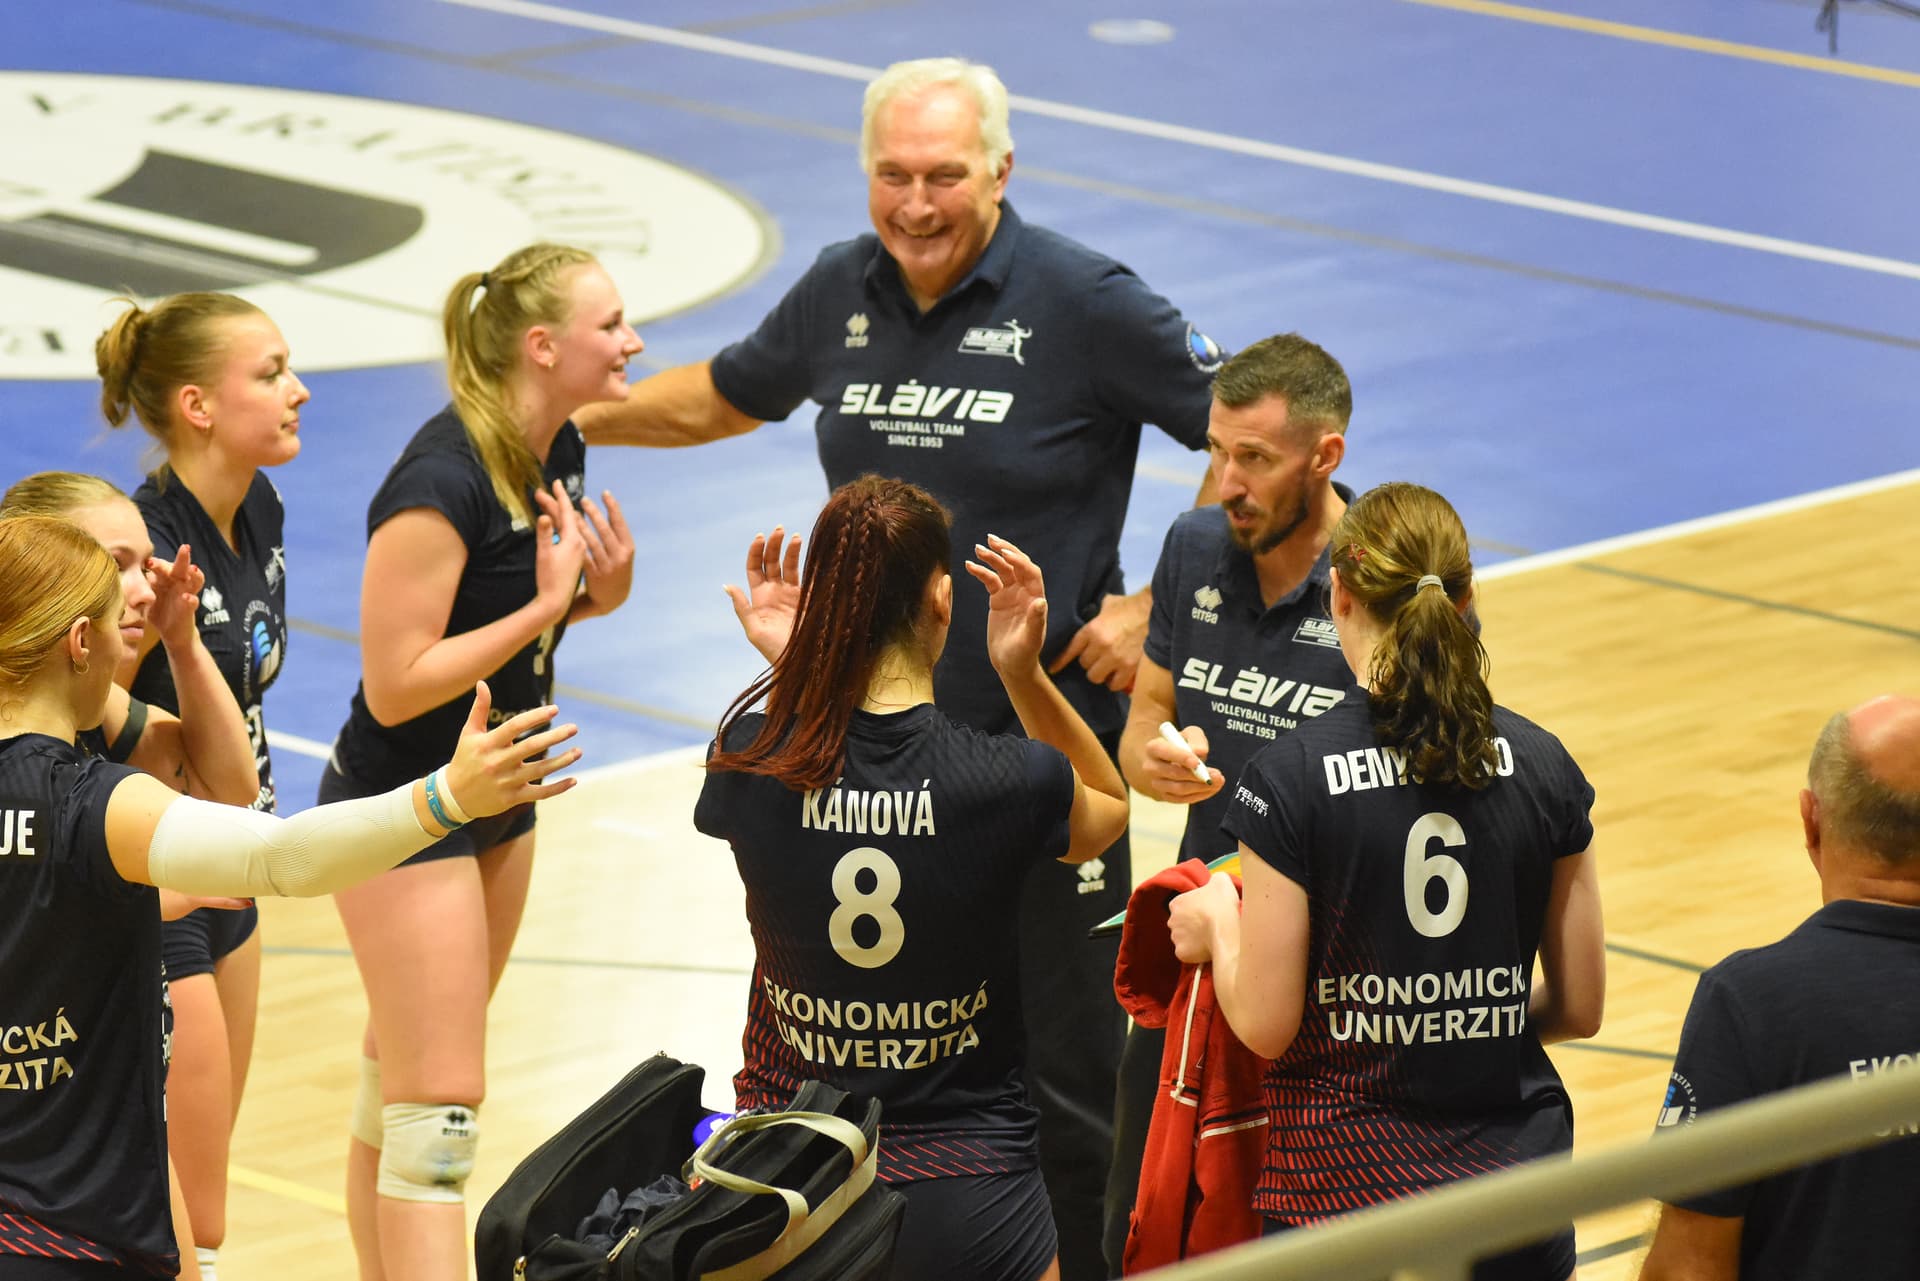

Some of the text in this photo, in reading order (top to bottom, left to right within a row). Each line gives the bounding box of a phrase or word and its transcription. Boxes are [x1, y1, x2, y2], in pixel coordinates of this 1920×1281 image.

[869, 419, 964, 436] VOLLEYBALL TEAM
[888, 434, 943, 449] SINCE 1953
[1211, 701, 1297, 730] VOLLEYBALL TEAM
[1226, 718, 1277, 741] SINCE 1953
[801, 777, 936, 837] KÁNOVÁ
[1403, 811, 1469, 938] 6
[828, 846, 906, 969] 8
[763, 975, 989, 1032] EKONOMICKÁ
[1318, 963, 1526, 1007] EKONOMICK
[775, 1012, 980, 1070] UNIVERZITA
